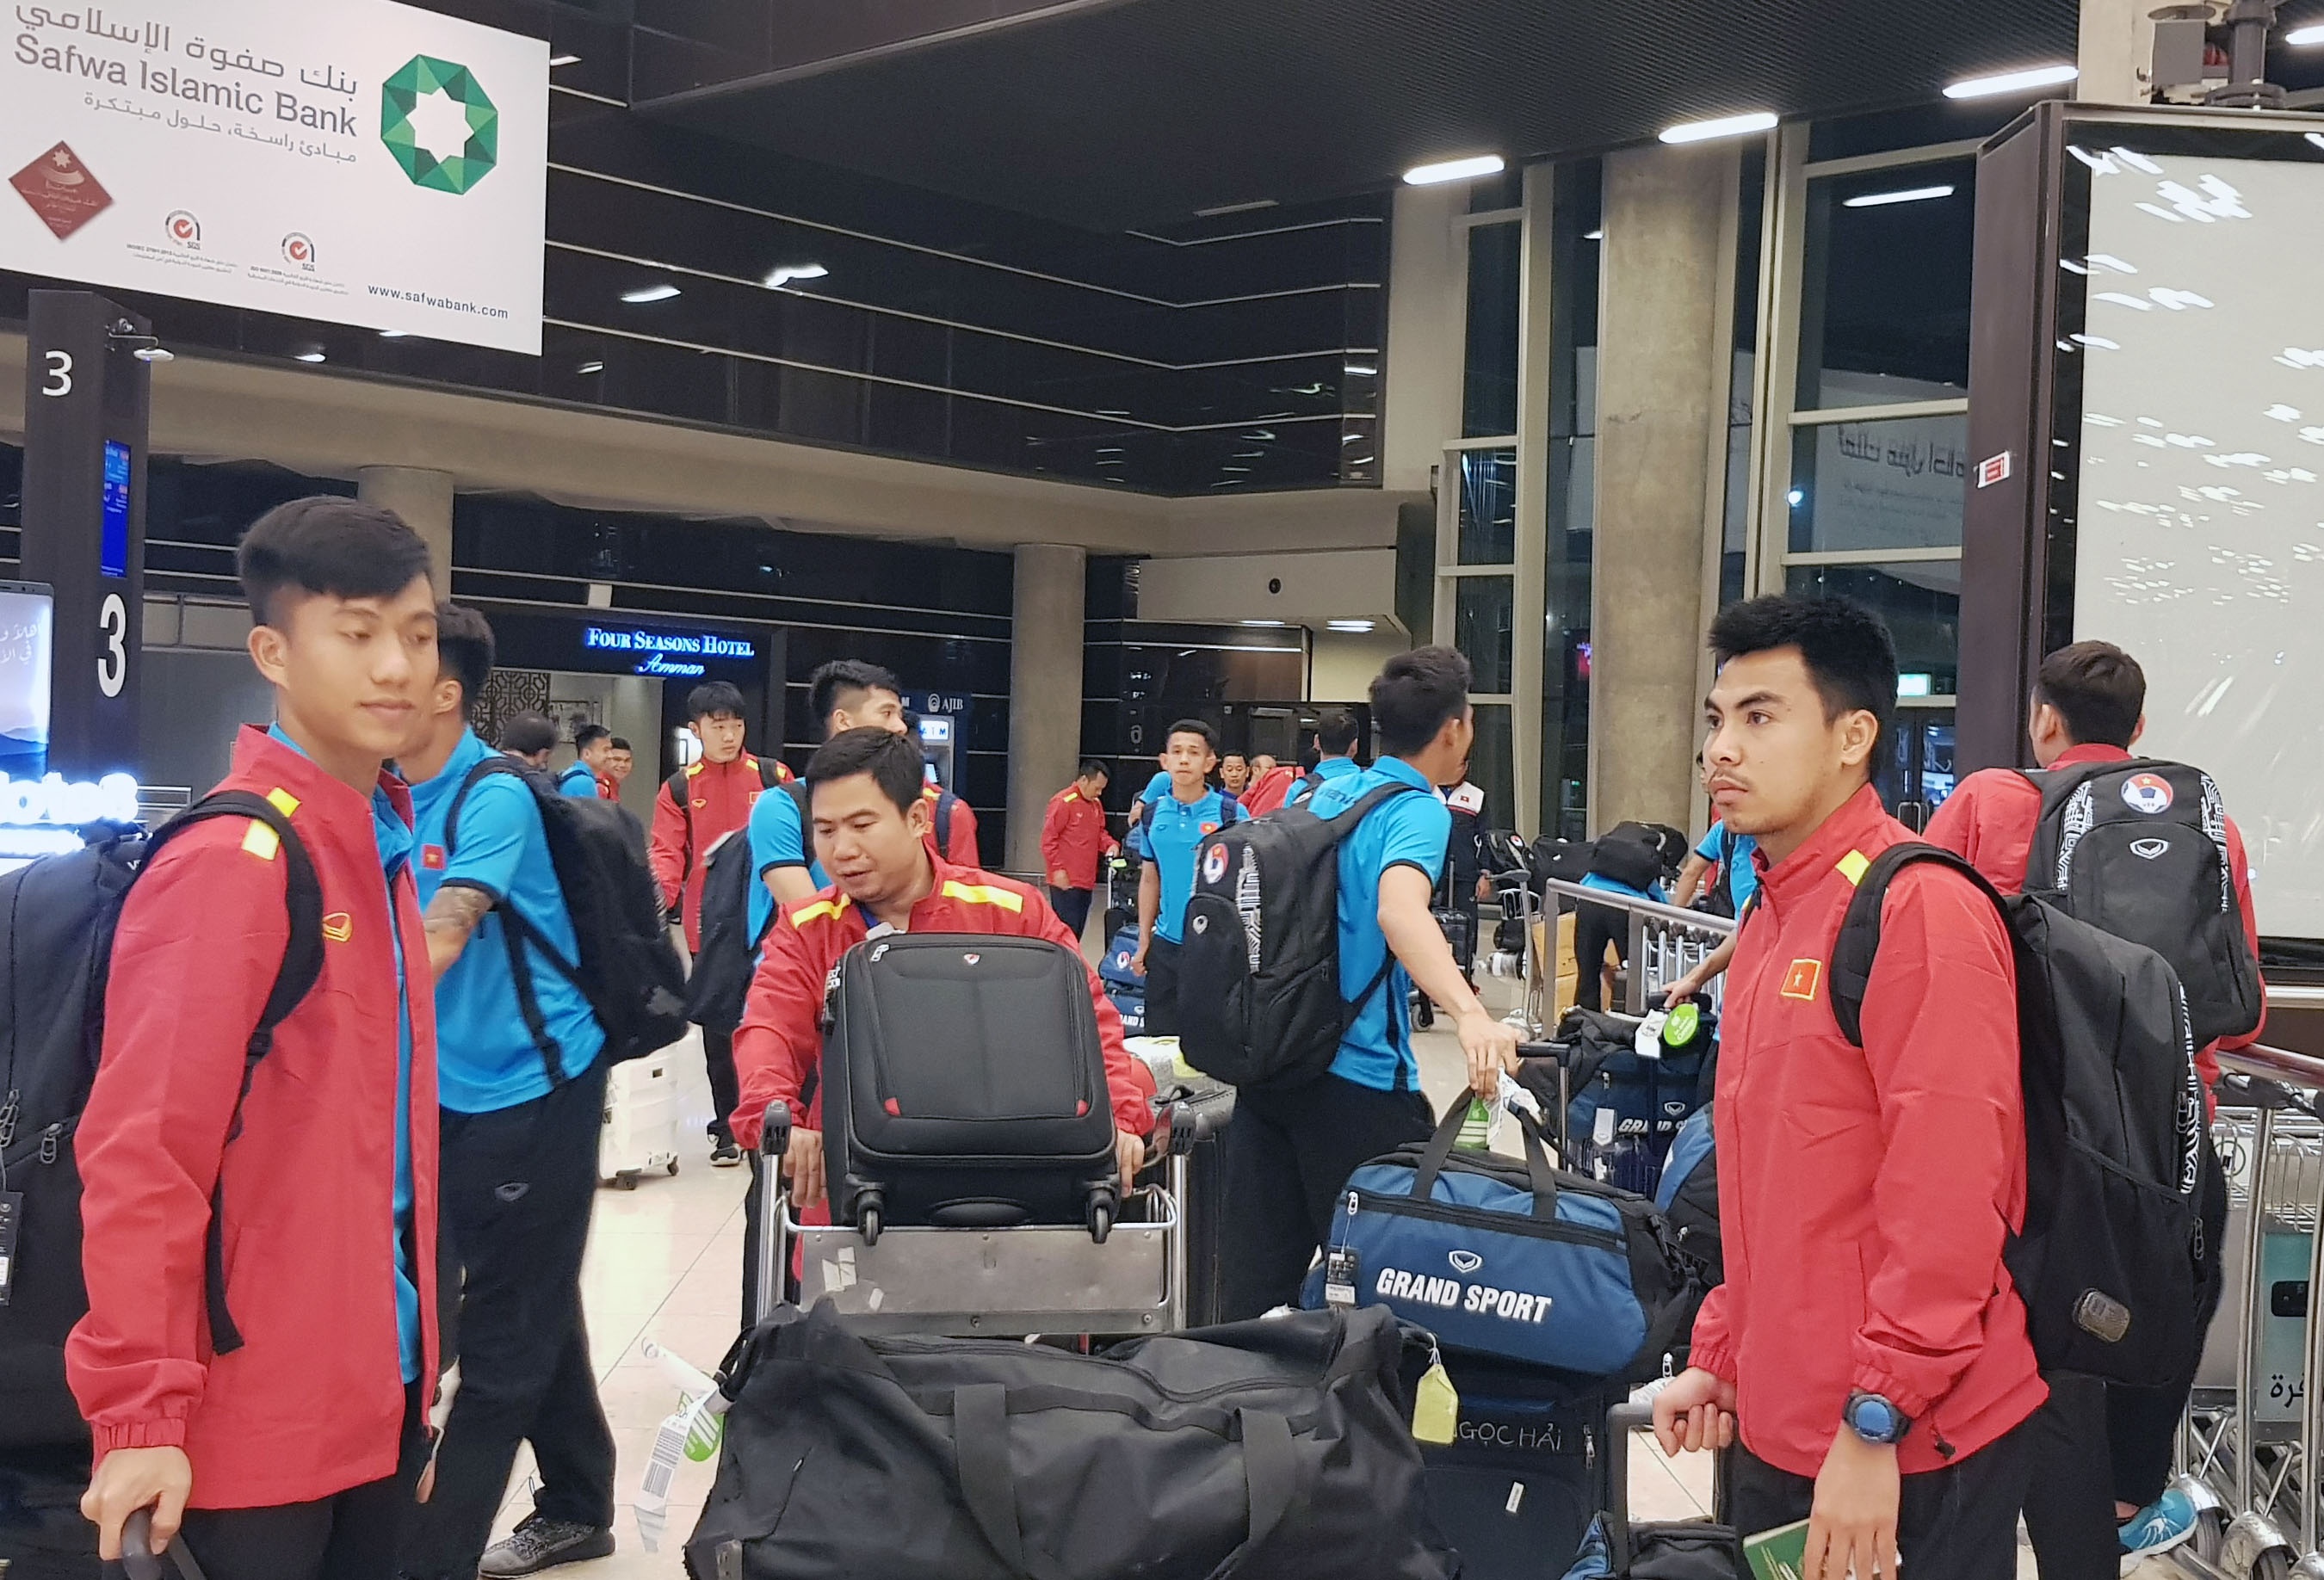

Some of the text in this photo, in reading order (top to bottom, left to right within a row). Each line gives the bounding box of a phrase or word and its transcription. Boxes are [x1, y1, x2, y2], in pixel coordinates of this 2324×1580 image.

[15, 5, 357, 102] بنك صفوة الإسلامي
[15, 34, 357, 137] Safwa Islamic Bank
[84, 91, 162, 120] مبتكرة
[167, 109, 221, 132] حلول
[368, 285, 509, 319] www.safwabank.com
[42, 350, 72, 397] 3
[97, 593, 127, 698] 3
[587, 627, 755, 657] FOUR SEASONS HOTEL
[637, 652, 705, 676] Amman
[942, 698, 963, 713] AJIB
[1376, 1268, 1461, 1307] GRAND
[1463, 1284, 1552, 1324] SPORT
[1455, 1421, 1515, 1447] GỌC
